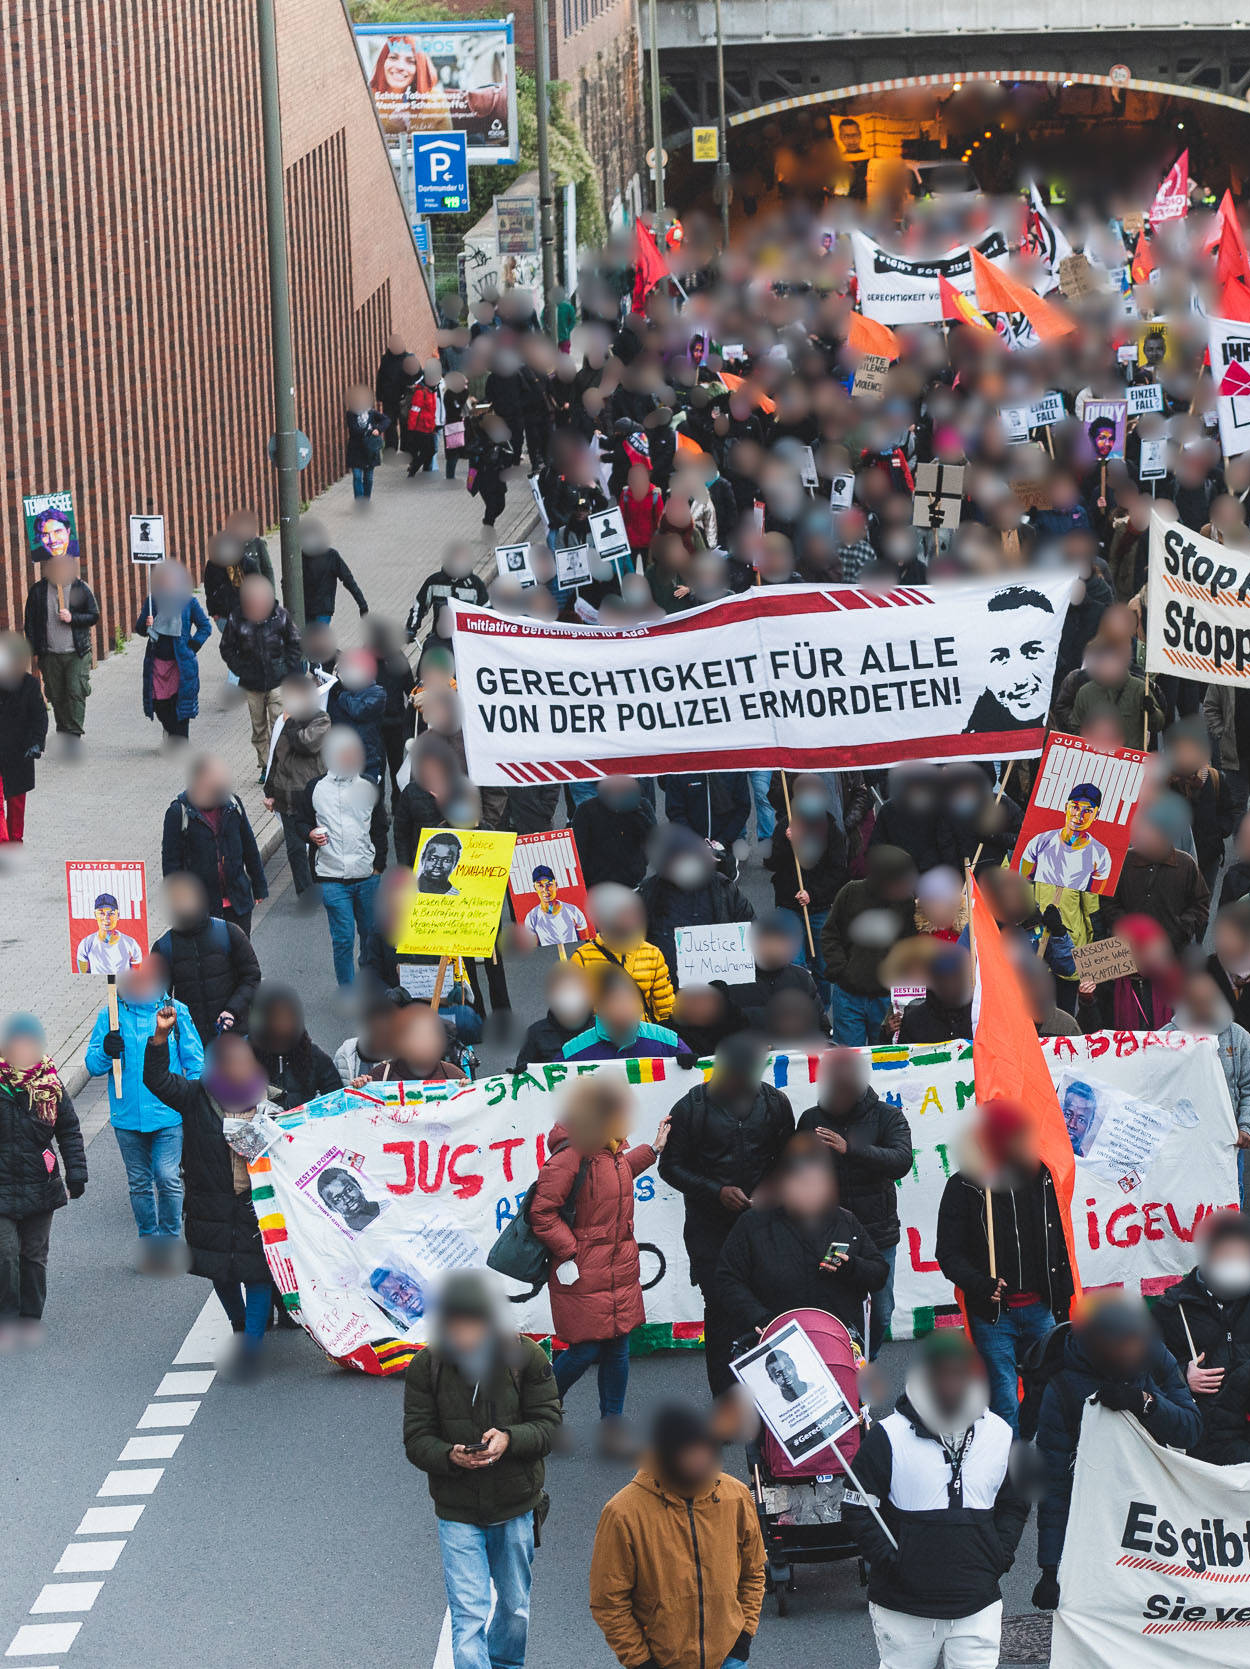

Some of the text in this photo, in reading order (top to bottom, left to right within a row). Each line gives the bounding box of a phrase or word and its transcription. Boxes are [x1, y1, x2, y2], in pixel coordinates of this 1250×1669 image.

[430, 153, 451, 182] P
[418, 184, 464, 193] Dortmunder U
[867, 293, 940, 302] GERECHTIGKEIT VO
[865, 355, 886, 366] HITE
[1131, 388, 1158, 401] EINZEL
[1135, 399, 1154, 411] FALL
[1036, 410, 1057, 423] FALL
[1163, 529, 1237, 598] Stop
[467, 618, 519, 634] Initiative
[476, 636, 958, 696] GERECHTIGKEIT FÜR ALLE
[478, 676, 962, 734] VON DER POLIZEI ERMORDETEN!
[515, 831, 570, 846] STICE FOR
[1072, 939, 1122, 960] RASSISMUS
[684, 960, 694, 976] 4
[1080, 960, 1092, 969] ist
[1094, 955, 1111, 965] eine
[1091, 961, 1134, 980] KAPITALS!
[294, 1144, 339, 1187] REST IN POWER
[790, 1408, 845, 1446] #Gerechtigkeit
[1142, 1594, 1206, 1623] Sie
